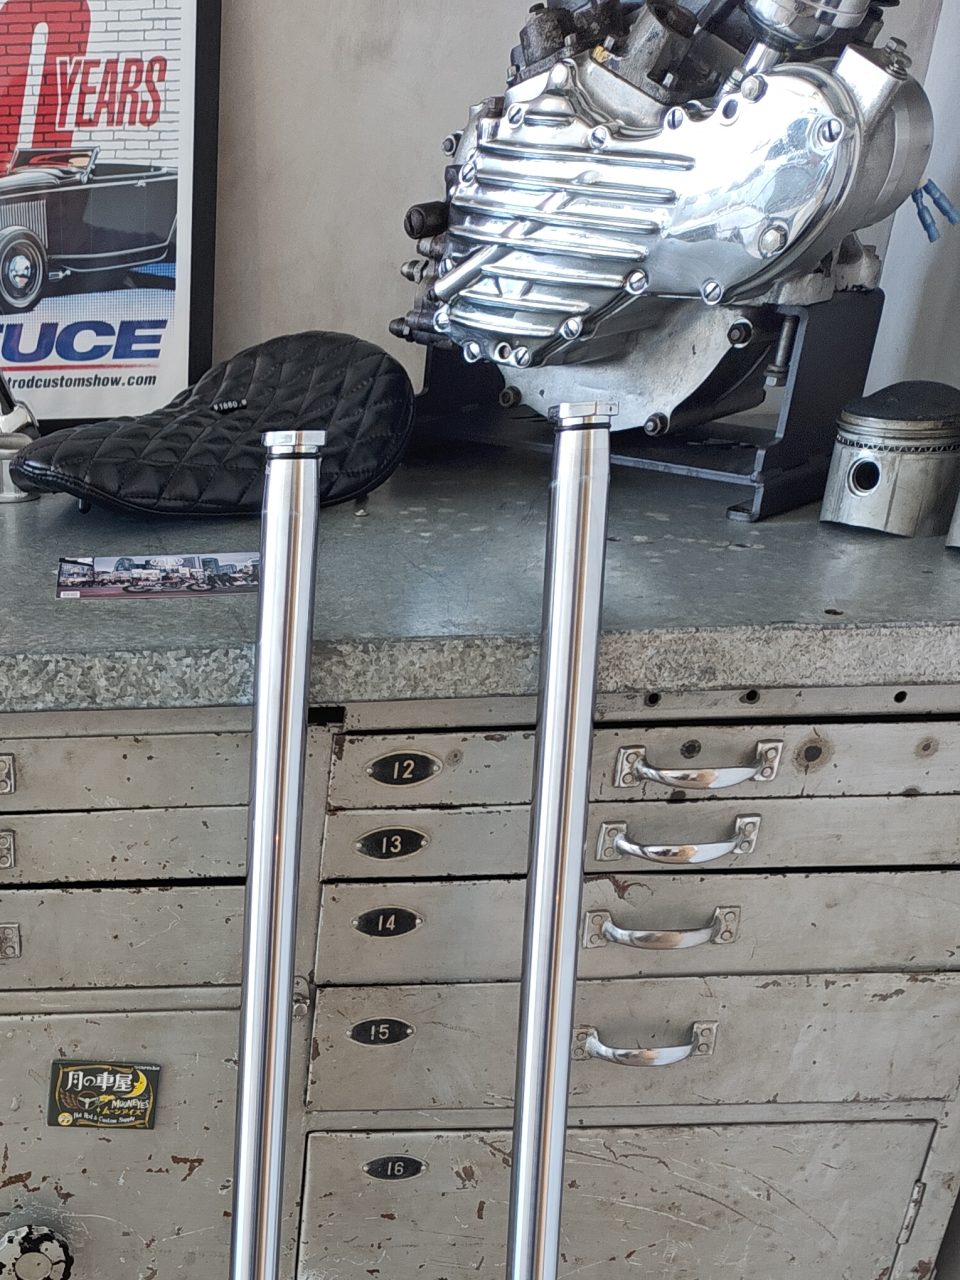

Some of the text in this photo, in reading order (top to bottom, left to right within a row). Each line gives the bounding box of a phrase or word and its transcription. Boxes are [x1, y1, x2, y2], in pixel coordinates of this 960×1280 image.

[56, 55, 167, 129] YEARS
[393, 759, 415, 779] 12
[382, 835, 402, 854] 13
[378, 914, 396, 931] 14
[370, 1024, 390, 1041] 15
[65, 1070, 133, 1092] 月の車屋
[386, 1161, 405, 1176] 16
